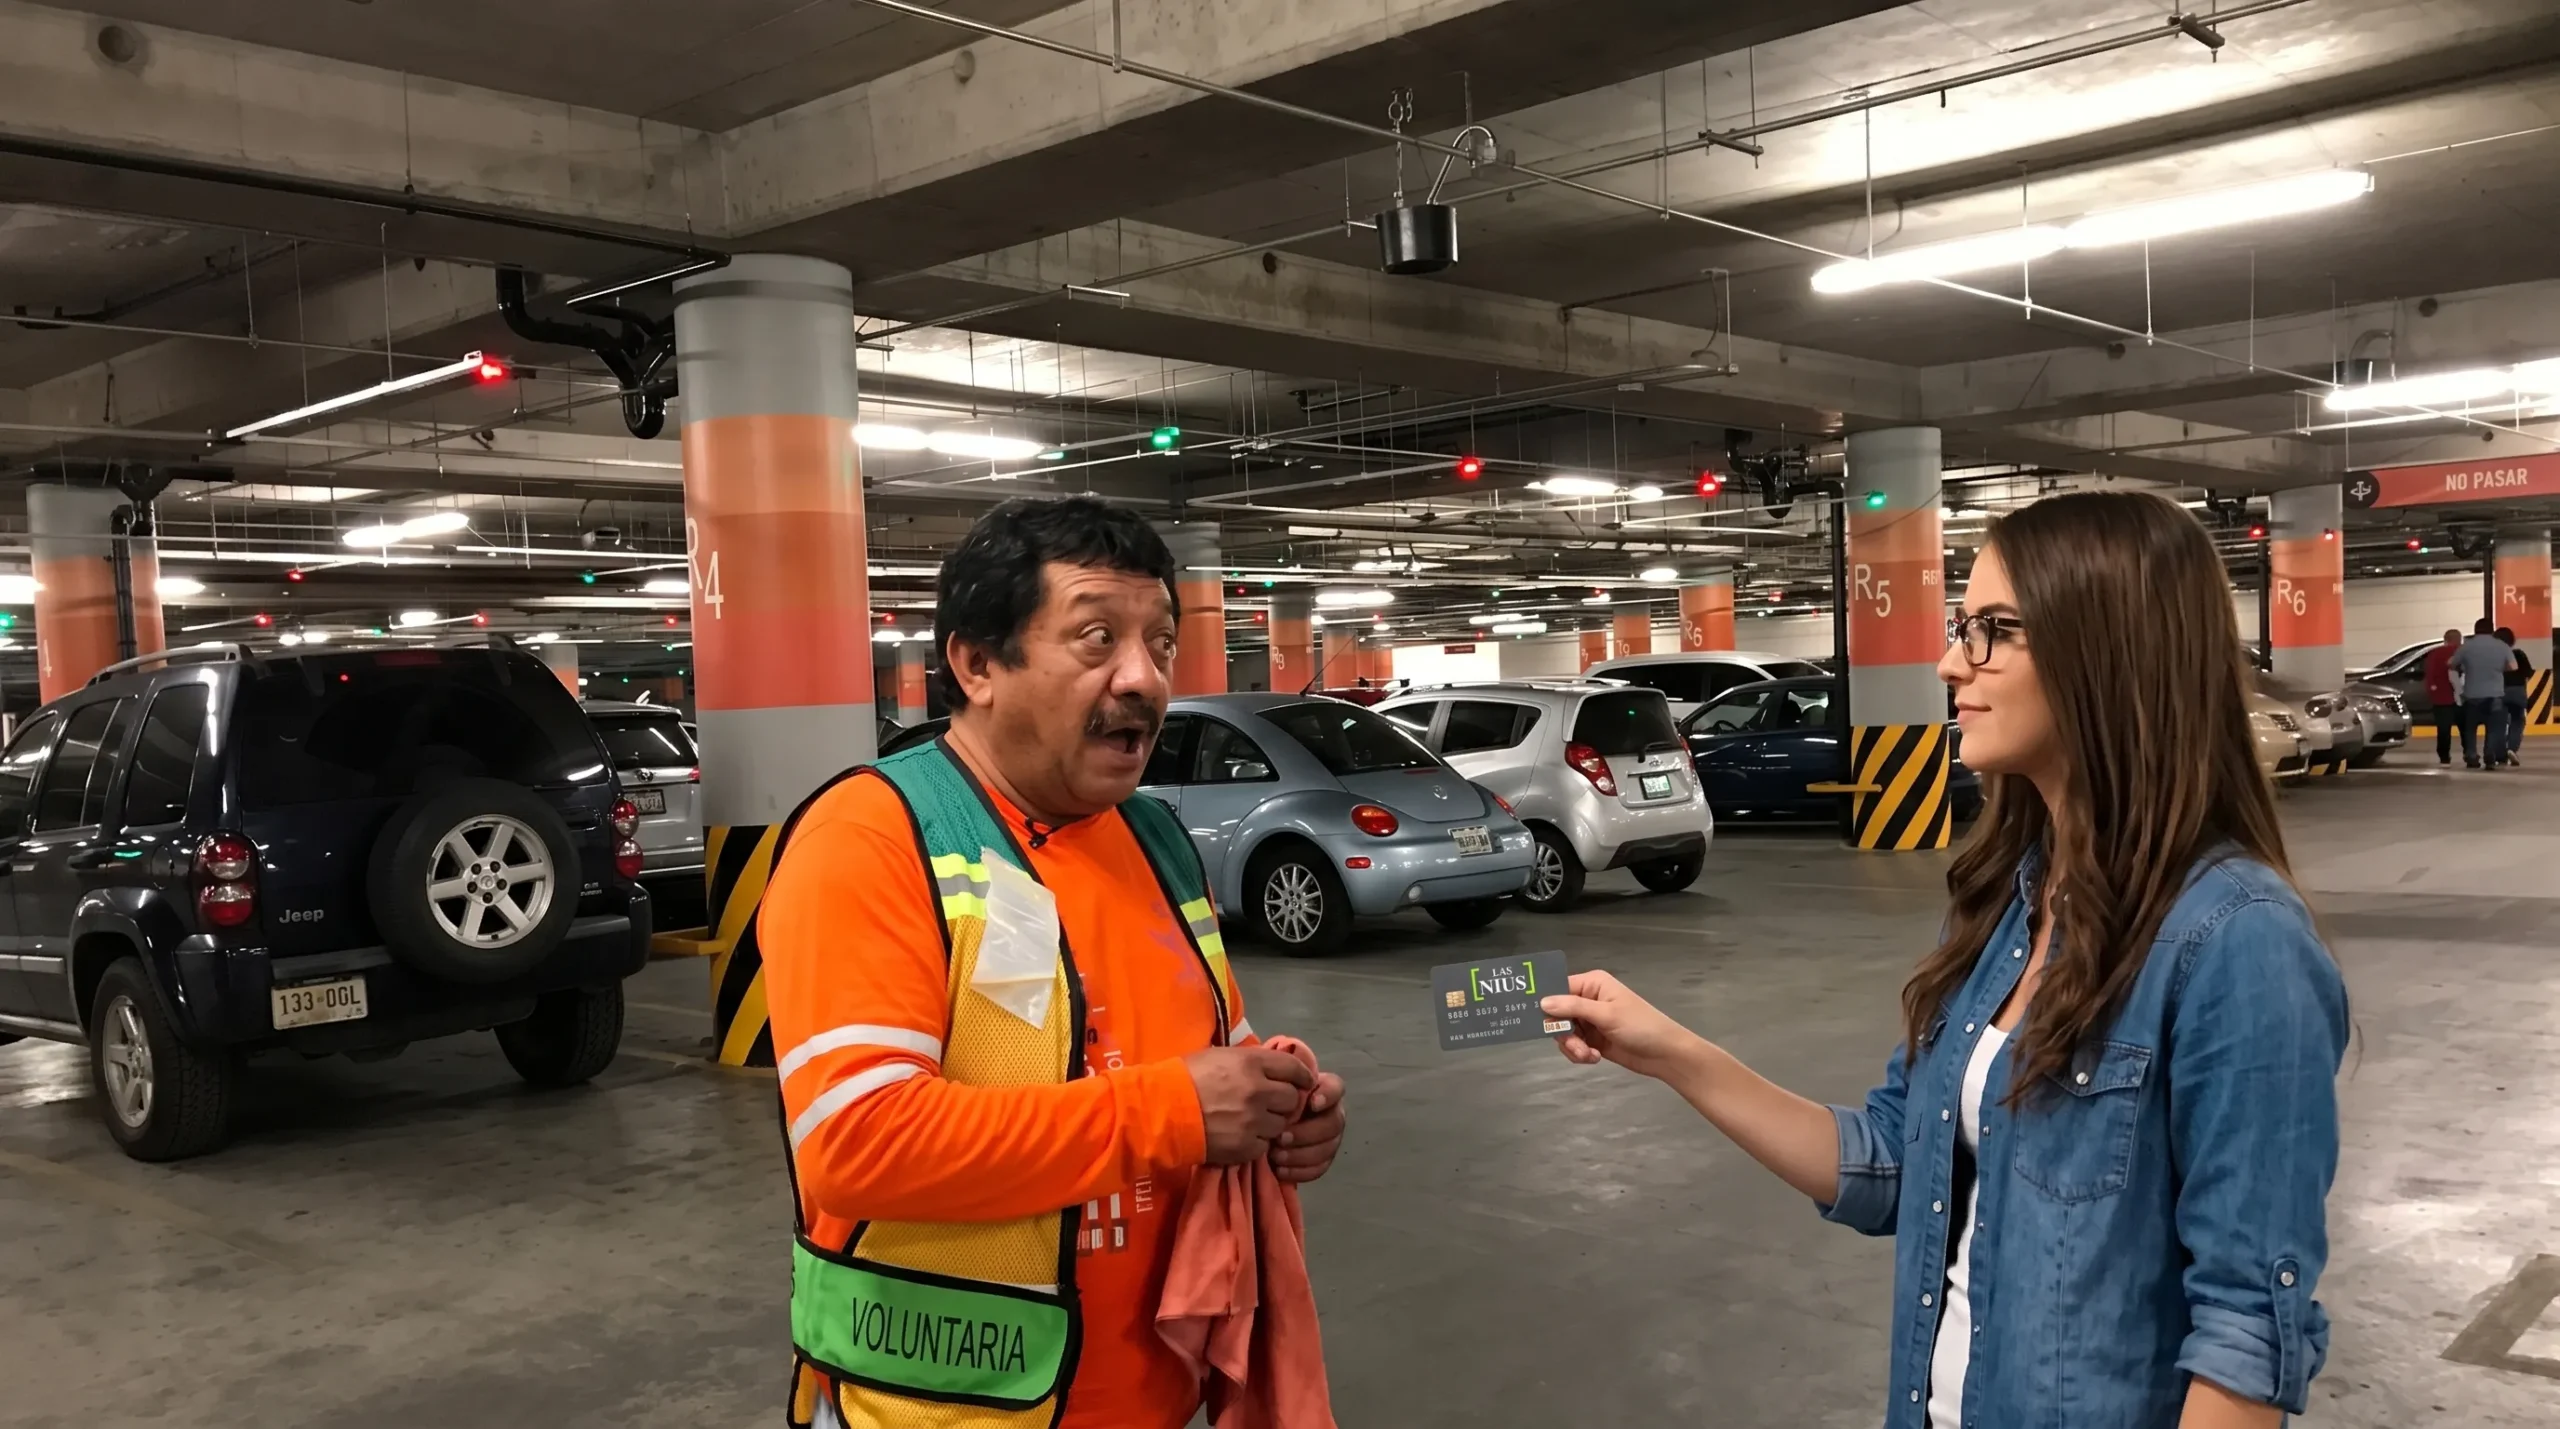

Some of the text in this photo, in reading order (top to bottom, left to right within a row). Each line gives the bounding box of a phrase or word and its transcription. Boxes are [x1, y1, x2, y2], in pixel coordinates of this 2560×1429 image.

[2446, 468, 2528, 491] NO PASAR
[686, 517, 725, 620] R4
[1854, 563, 1892, 618] R5
[2277, 579, 2306, 616] R6
[2503, 585, 2526, 614] R1
[1684, 620, 1703, 647] R6
[279, 909, 324, 923] Jeep
[1478, 975, 1527, 995] NIUS
[1492, 966, 1513, 977] LAS
[853, 1297, 1026, 1373] VOLUNTARIA
